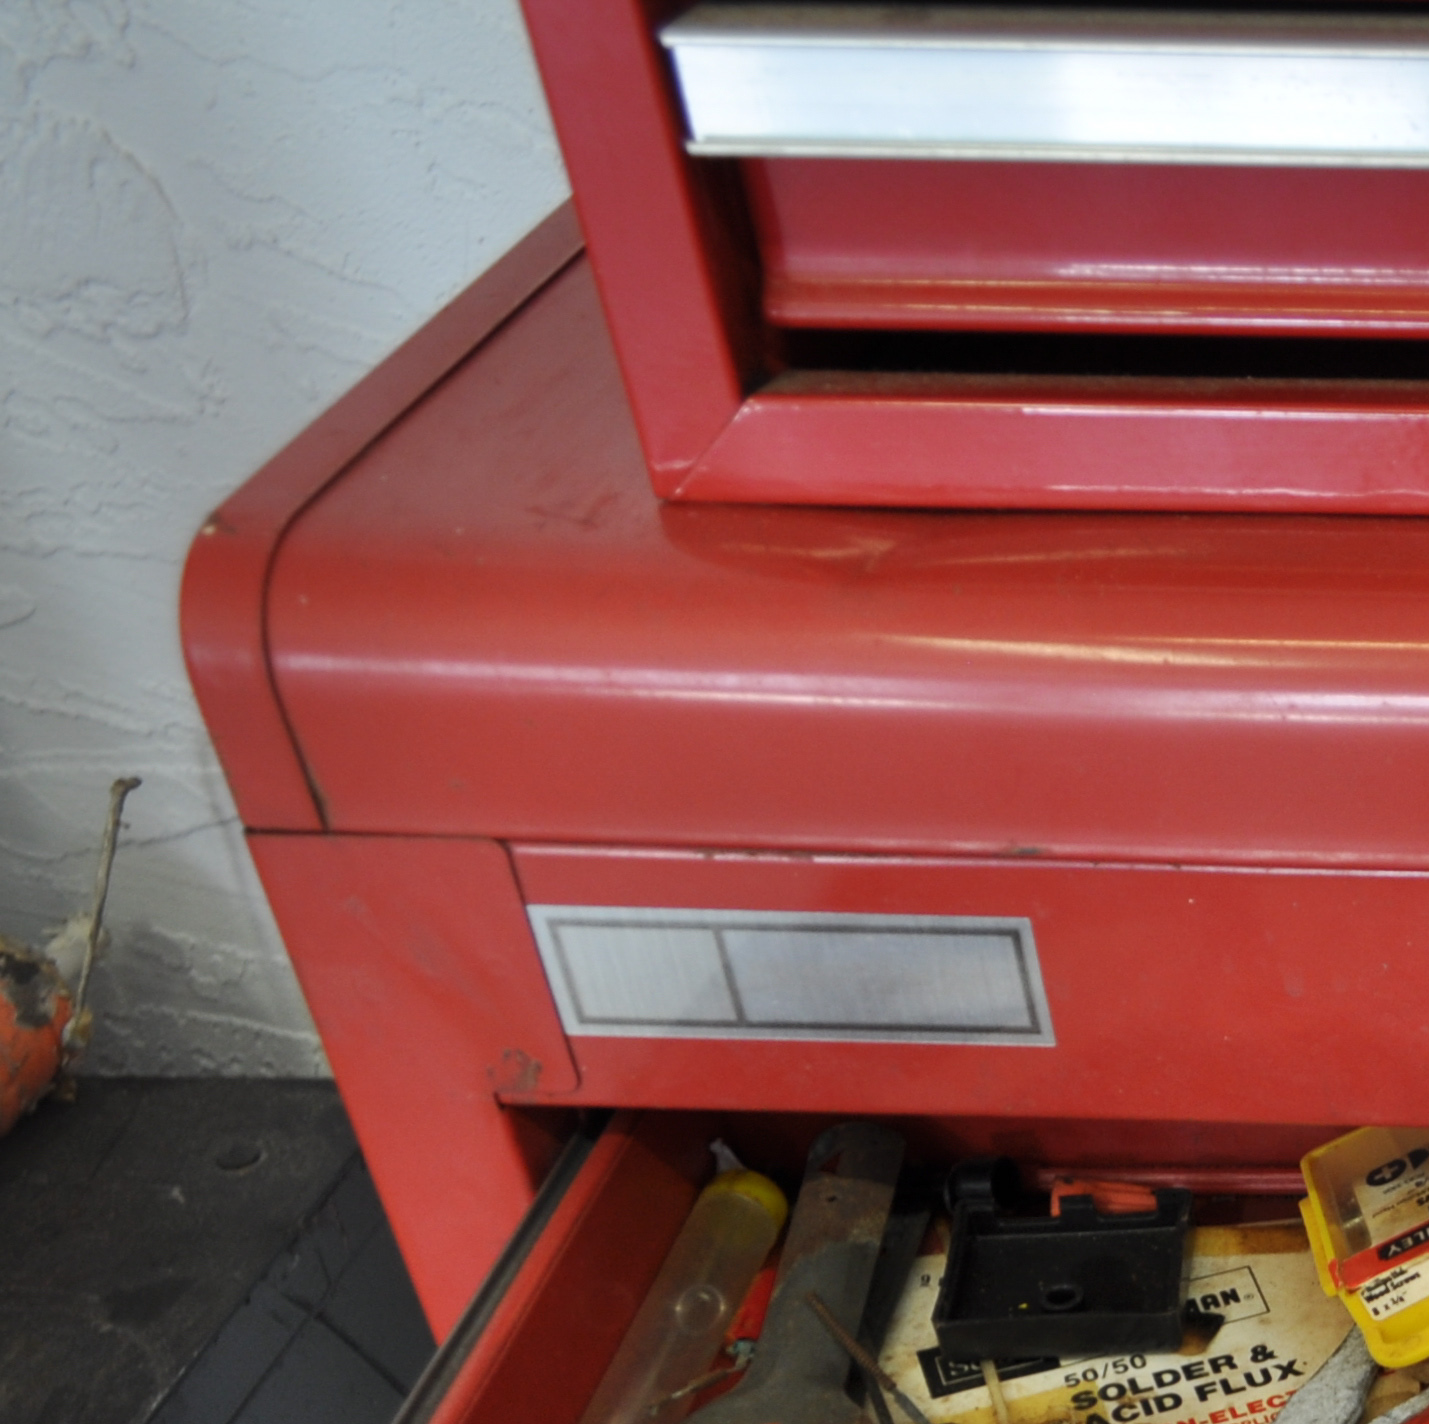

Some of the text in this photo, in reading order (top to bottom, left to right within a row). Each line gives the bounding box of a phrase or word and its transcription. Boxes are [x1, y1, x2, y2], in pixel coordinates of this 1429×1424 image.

[1063, 1353, 1148, 1388] 50/50
[1070, 1344, 1278, 1411] SOLDER &
[1194, 1359, 1306, 1403] FLUX
